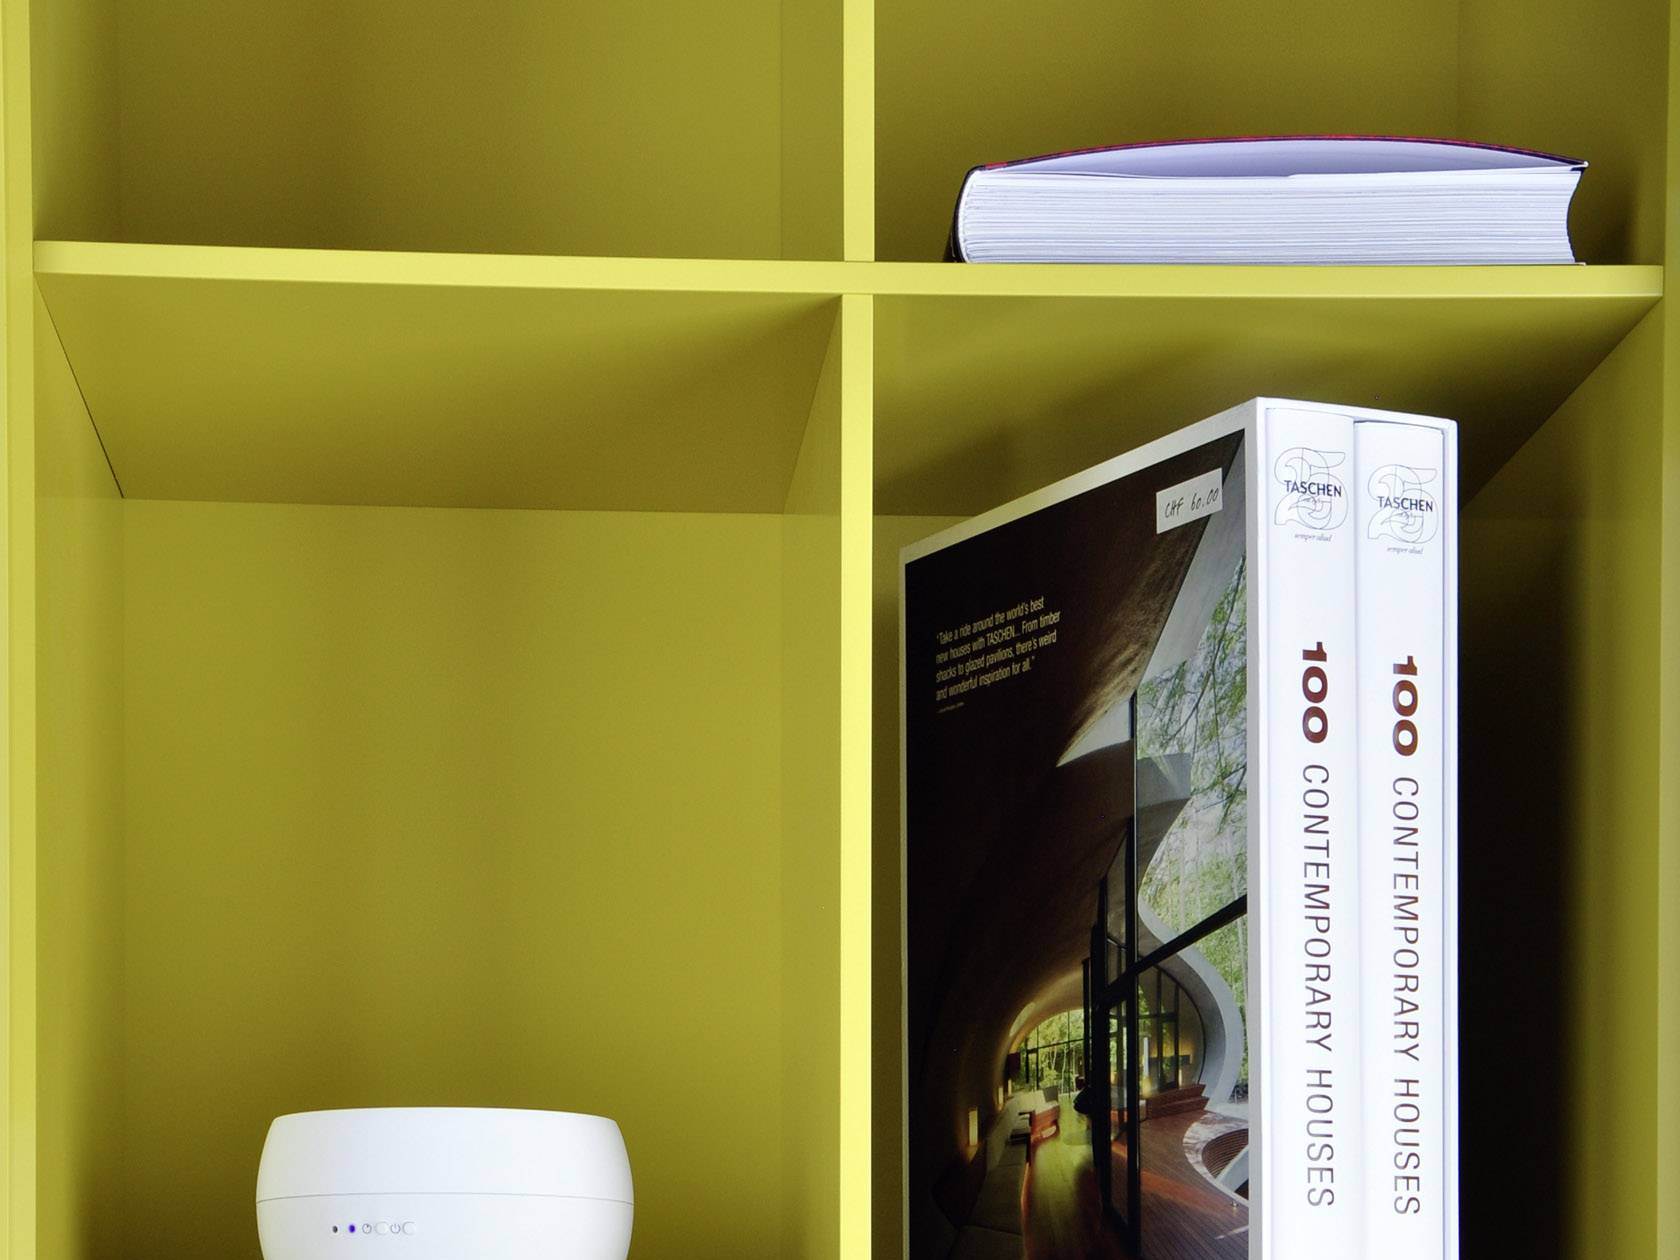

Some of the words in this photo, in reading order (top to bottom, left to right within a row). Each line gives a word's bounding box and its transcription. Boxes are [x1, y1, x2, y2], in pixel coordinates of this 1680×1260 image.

[1165, 497, 1184, 518] CHF
[1191, 488, 1219, 511] 60.00
[1284, 480, 1342, 497] TASCHEN
[1377, 496, 1433, 512] TASCHEN
[936, 651, 949, 664] new
[949, 643, 971, 660] houses
[972, 635, 985, 652] with
[1021, 619, 1039, 634] From
[1039, 611, 1061, 628] timber
[953, 629, 959, 640] a
[960, 623, 971, 637] ride
[972, 614, 994, 633] around
[995, 611, 1005, 625] the
[1006, 601, 1029, 620] world's
[1030, 596, 1044, 612] best
[936, 666, 957, 683] shacks
[957, 663, 965, 675] to
[965, 654, 985, 675] glazed
[1015, 636, 1038, 655] there's
[1038, 629, 1057, 647] weird
[936, 685, 948, 701] and
[948, 675, 978, 697] wonderful
[979, 665, 1011, 688] inspiration
[1011, 661, 1021, 675] for
[1302, 641, 1328, 744] 100
[1392, 655, 1418, 757] 100
[1302, 764, 1333, 1053] CONTEMPORARY
[1392, 777, 1421, 1062] CONTEMPORARY
[1305, 1068, 1335, 1207] HOUSES
[1393, 1078, 1421, 1215] HOUSES
